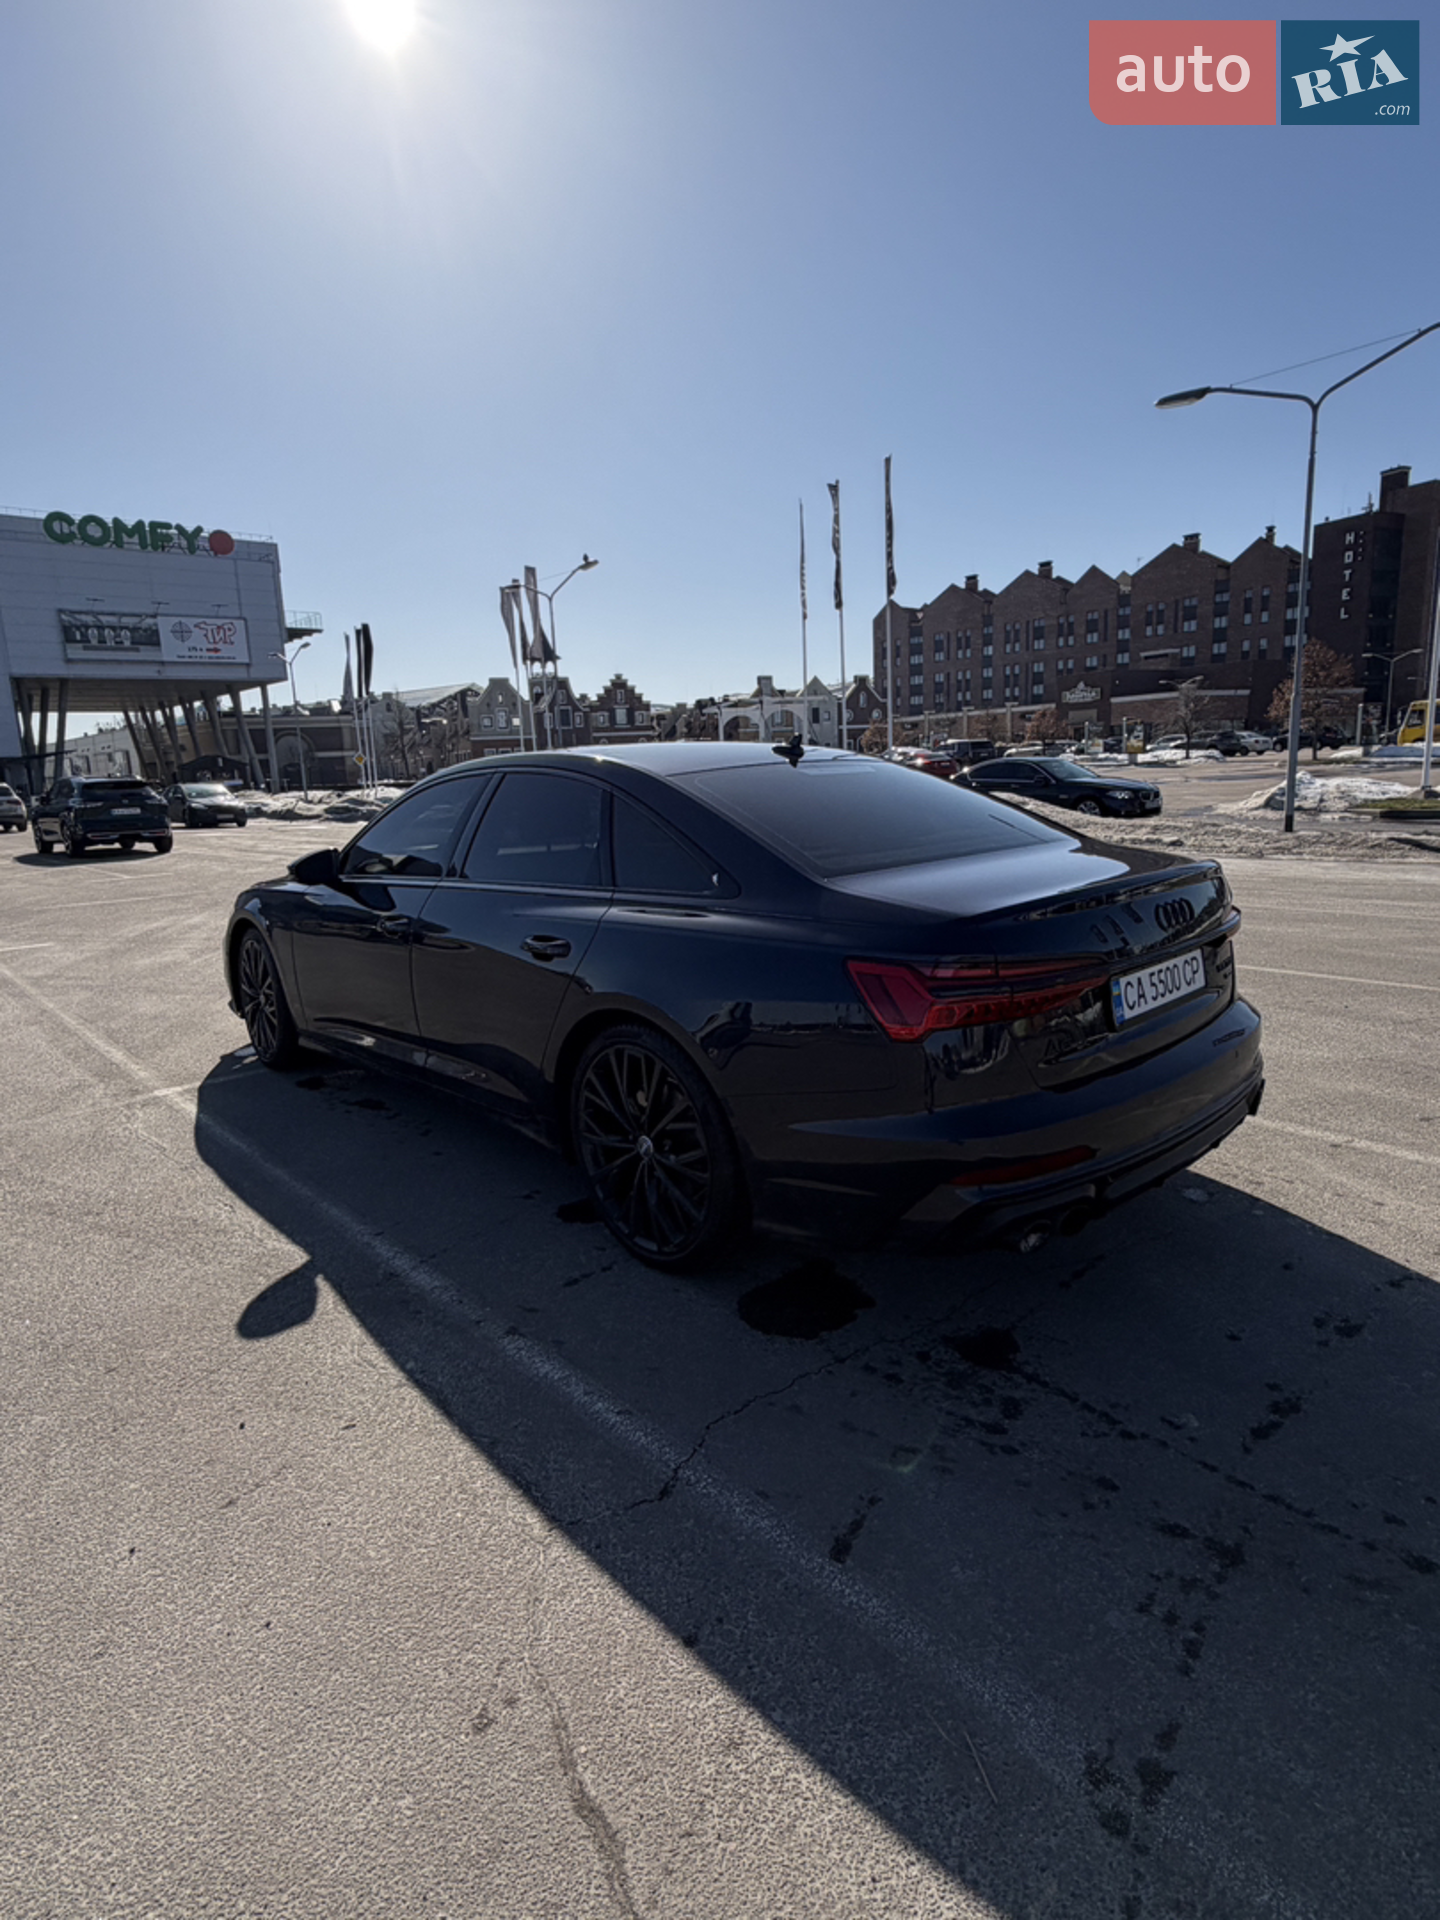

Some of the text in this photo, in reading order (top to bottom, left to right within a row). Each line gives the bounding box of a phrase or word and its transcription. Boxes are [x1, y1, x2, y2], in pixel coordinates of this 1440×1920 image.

[43, 511, 203, 555] COMFY
[1340, 531, 1355, 620] HOTEL
[1124, 977, 1147, 1010] CA
[1149, 965, 1181, 1001] 5500
[1182, 956, 1200, 987] CP
